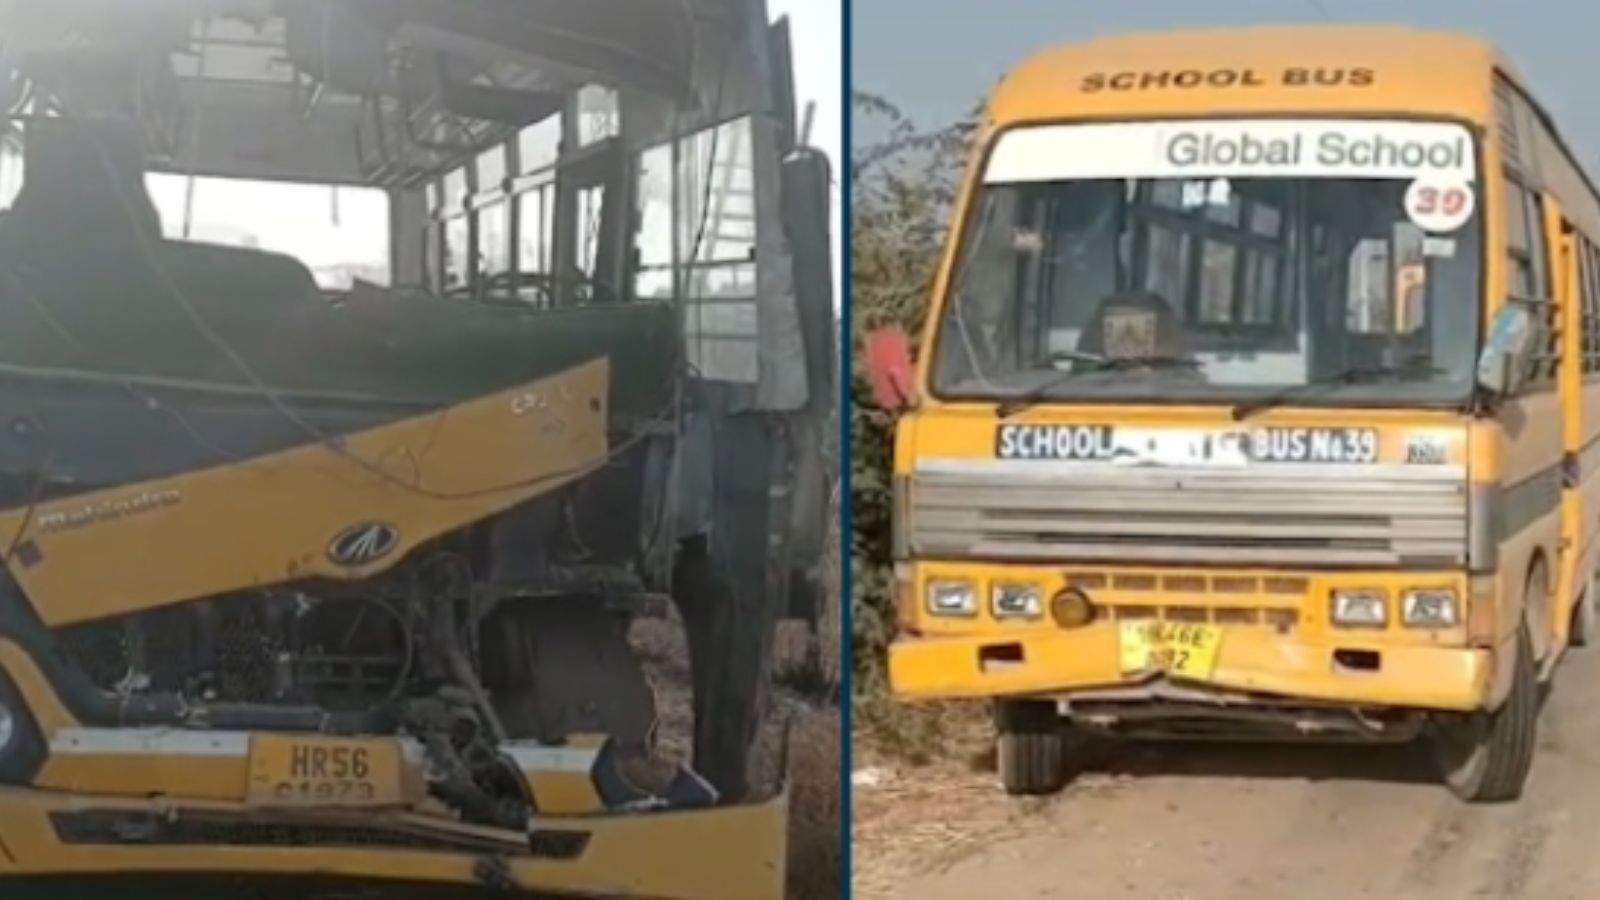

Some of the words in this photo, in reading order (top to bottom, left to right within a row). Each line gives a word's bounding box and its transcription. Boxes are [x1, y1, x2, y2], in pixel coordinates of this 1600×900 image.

[1080, 69, 1264, 93] SCHOOL
[1281, 66, 1376, 88] BUS
[1166, 132, 1301, 167] Global
[1315, 134, 1465, 169] School
[1001, 426, 1114, 458] SCHOOL
[1253, 427, 1306, 460] BUS
[290, 744, 369, 778] HR56
